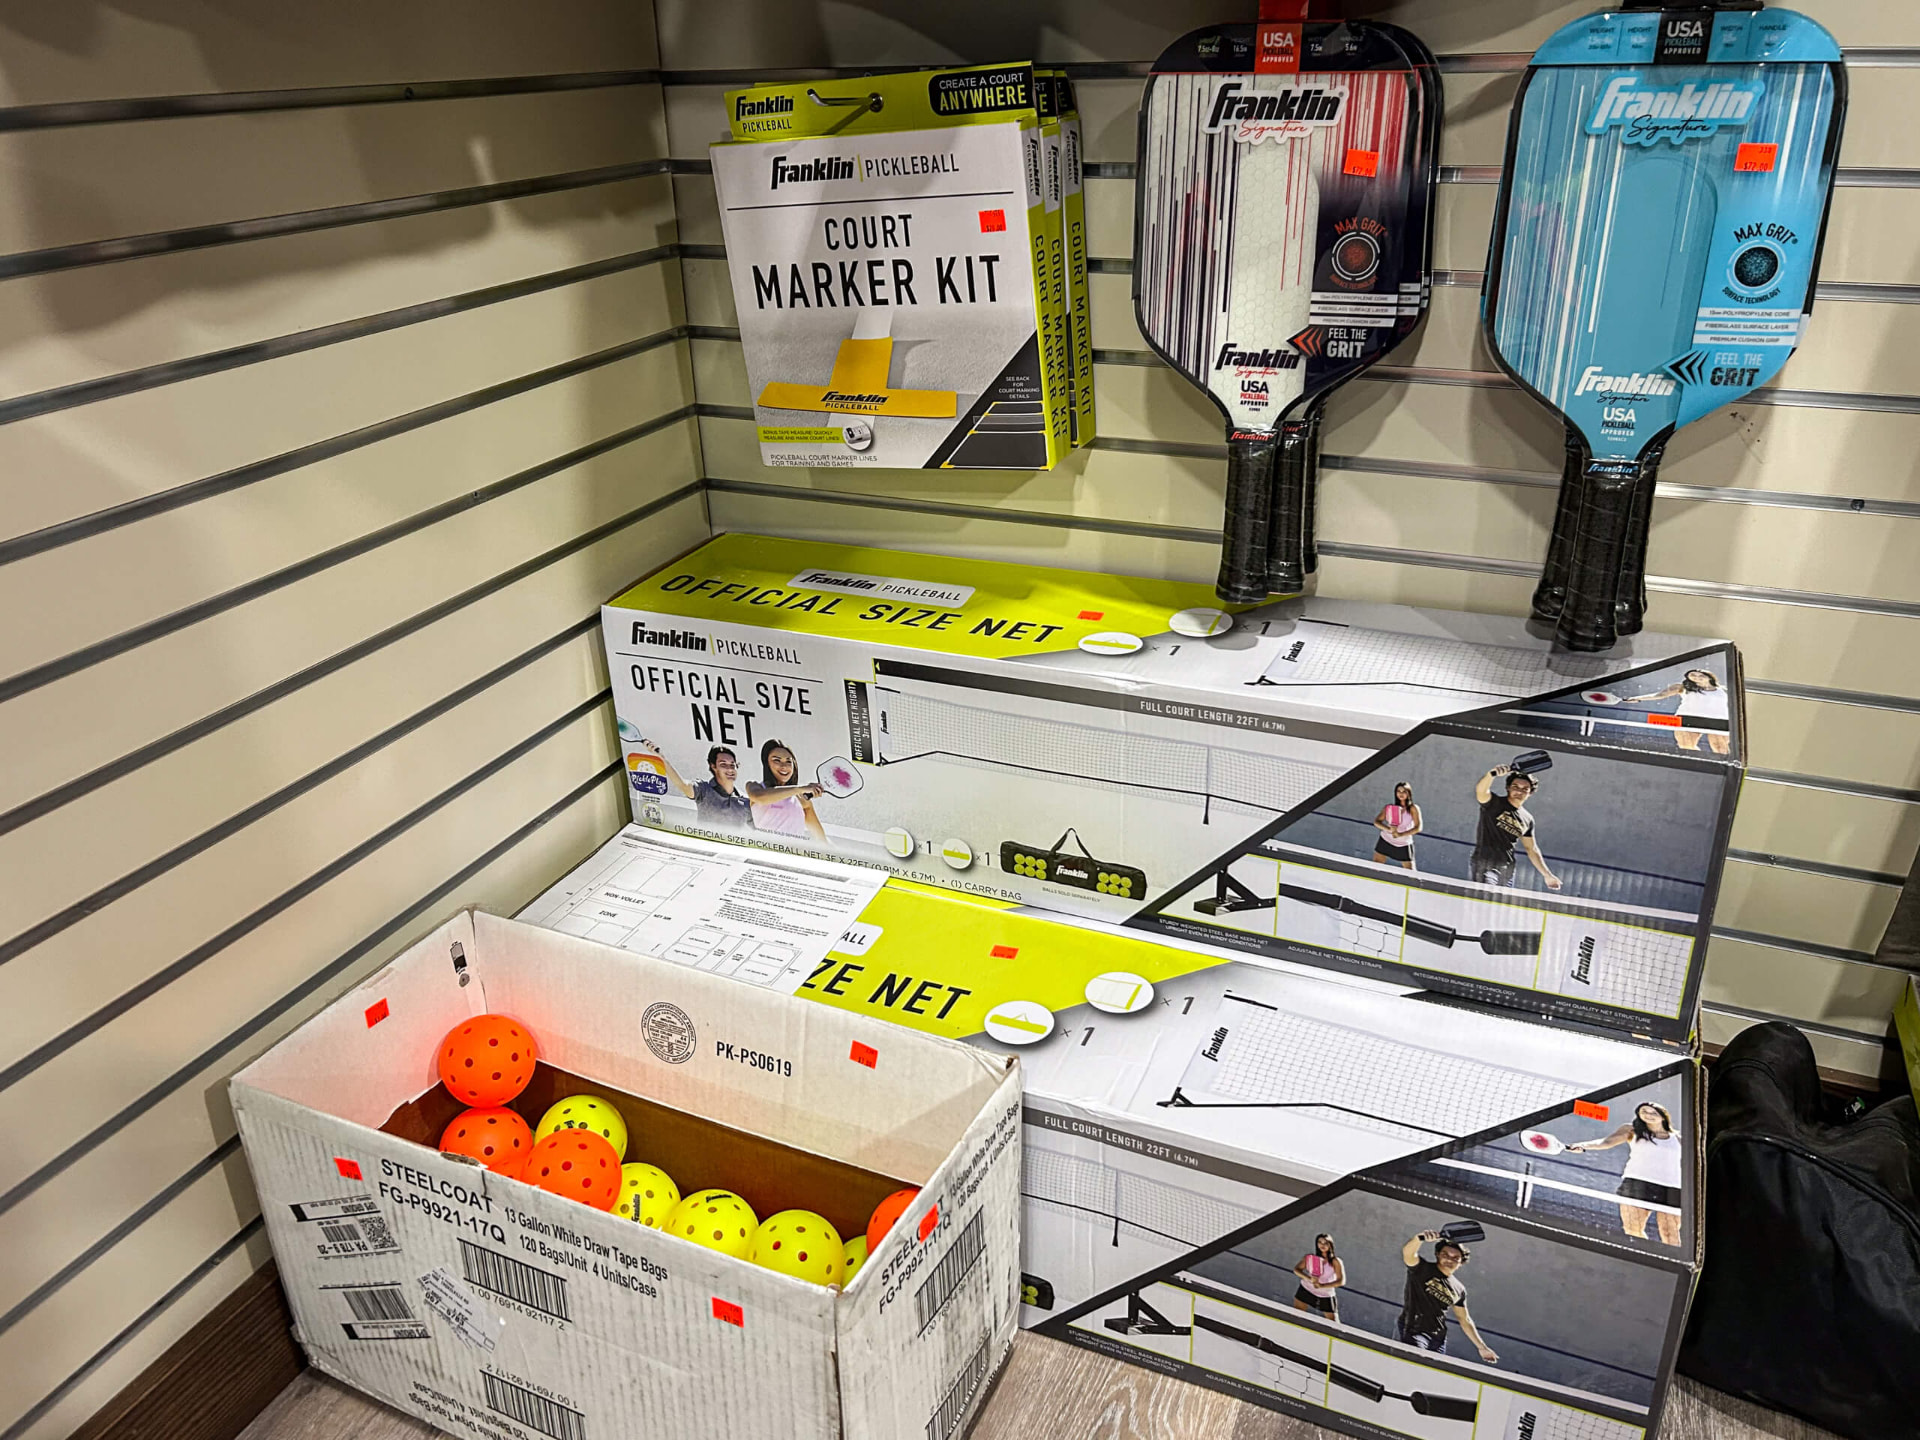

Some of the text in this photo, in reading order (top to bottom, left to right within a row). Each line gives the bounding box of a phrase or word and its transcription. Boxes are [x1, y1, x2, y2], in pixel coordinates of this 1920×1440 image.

[1263, 32, 1294, 47] USA
[1665, 37, 1702, 46] PICKLEBALL
[1667, 21, 1704, 38] USA
[1663, 47, 1702, 55] APPROVED
[939, 72, 1024, 89] CREATE A COURT
[735, 95, 794, 121] Franklin
[940, 86, 1027, 112] ANYWHERE
[1208, 83, 1341, 128] Franklin
[1592, 76, 1754, 128] Franklin
[742, 118, 792, 134] PICKLEBALL
[1239, 118, 1309, 139] Signature
[1631, 115, 1711, 138] Signature
[771, 153, 960, 190] Franklin PICKLEBALL
[824, 213, 912, 250] COURT
[1334, 216, 1384, 237] MAX GRIT
[1733, 222, 1795, 245] MAX GRIT
[752, 255, 1000, 310] MARKER KIT
[1052, 239, 1062, 304] COURT
[1722, 287, 1781, 305] SURFACE TECHNOLOGY
[1072, 221, 1091, 415] COURT MARKER KIT
[1035, 234, 1061, 438] COURT MARKER KIT
[1328, 328, 1367, 340] FEEL THE
[1054, 315, 1066, 397] MARKER
[1215, 343, 1300, 370] Franklin
[1327, 341, 1365, 358] GRIT
[1714, 352, 1762, 366] FEEL THE
[1240, 381, 1269, 393] USA
[1575, 366, 1676, 396] Franklin
[1710, 367, 1760, 386] GRIT
[821, 390, 888, 404] Franklin
[825, 401, 879, 411] PICKLEBALL
[1240, 392, 1269, 400] PICKLEBALL
[1601, 421, 1635, 430] PICKLEBALL
[1603, 407, 1637, 421] USA
[1601, 429, 1634, 437] APPROVED
[800, 572, 961, 601] Franklin PICKLEBALL
[659, 573, 1063, 644] OFFICIAL SIZE NET
[632, 621, 801, 665] Franklin PICKLEBALL
[630, 663, 812, 715] OFFICIAL SIZE
[692, 704, 755, 748] NET
[848, 685, 863, 757] OFFICIAL NET HEIGHT
[1140, 701, 1163, 713] FULL
[1165, 704, 1195, 718] COURT
[1198, 709, 1233, 723] LENGTH
[1236, 714, 1259, 727] 22FT
[1056, 865, 1088, 880] Franklin
[604, 891, 645, 905] NON-VOLLEY
[950, 879, 1022, 901] (1) CARRY BAG
[598, 909, 618, 919] ZONE
[1159, 918, 1179, 927] STURDY
[1180, 921, 1208, 932] WEIGHTED
[1209, 928, 1224, 936] STEEL
[1225, 931, 1240, 939] BASE
[1241, 935, 1257, 943] KEEPS
[1165, 925, 1189, 934] UPRIGHT
[1210, 933, 1228, 942] WINDY
[1228, 937, 1261, 949] CONDITIONS
[1288, 945, 1322, 957] ADJUSTABLE
[1336, 955, 1360, 965] TENSION
[1361, 959, 1382, 969] STRAPS
[1571, 936, 1596, 985] Franklin
[803, 959, 971, 1019] ZE NET
[1413, 971, 1450, 984] INTEGRATED
[1475, 983, 1516, 996] TECHNOLOGY
[1556, 1000, 1569, 1008] HIGH
[1571, 1003, 1599, 1013] QUALITY
[1613, 1010, 1651, 1024] STRUCTURE
[716, 1041, 792, 1077] PK-PS0619
[957, 1164, 972, 1187] Gallon
[972, 1147, 985, 1170] White
[985, 1131, 996, 1151] Draw
[1007, 1102, 1019, 1120] Bags
[1044, 1116, 1068, 1131] FULL
[1072, 1122, 1103, 1139] COURT
[1106, 1130, 1143, 1150] LENGTH
[1146, 1140, 1170, 1158] 22FT
[381, 1158, 492, 1213] STEELCOAT
[379, 1182, 506, 1245] FG-P9921-17Q
[504, 1207, 668, 1281] 13 Gallon White Draw Tape Bags
[519, 1234, 657, 1298] 120 Bags/Unit 4 Units/Case
[478, 1289, 491, 1301] 00
[492, 1294, 524, 1315] 76914
[527, 1304, 557, 1327] 92117
[1205, 1373, 1306, 1410] ADJUSTABLE NET TENSION STRAPS
